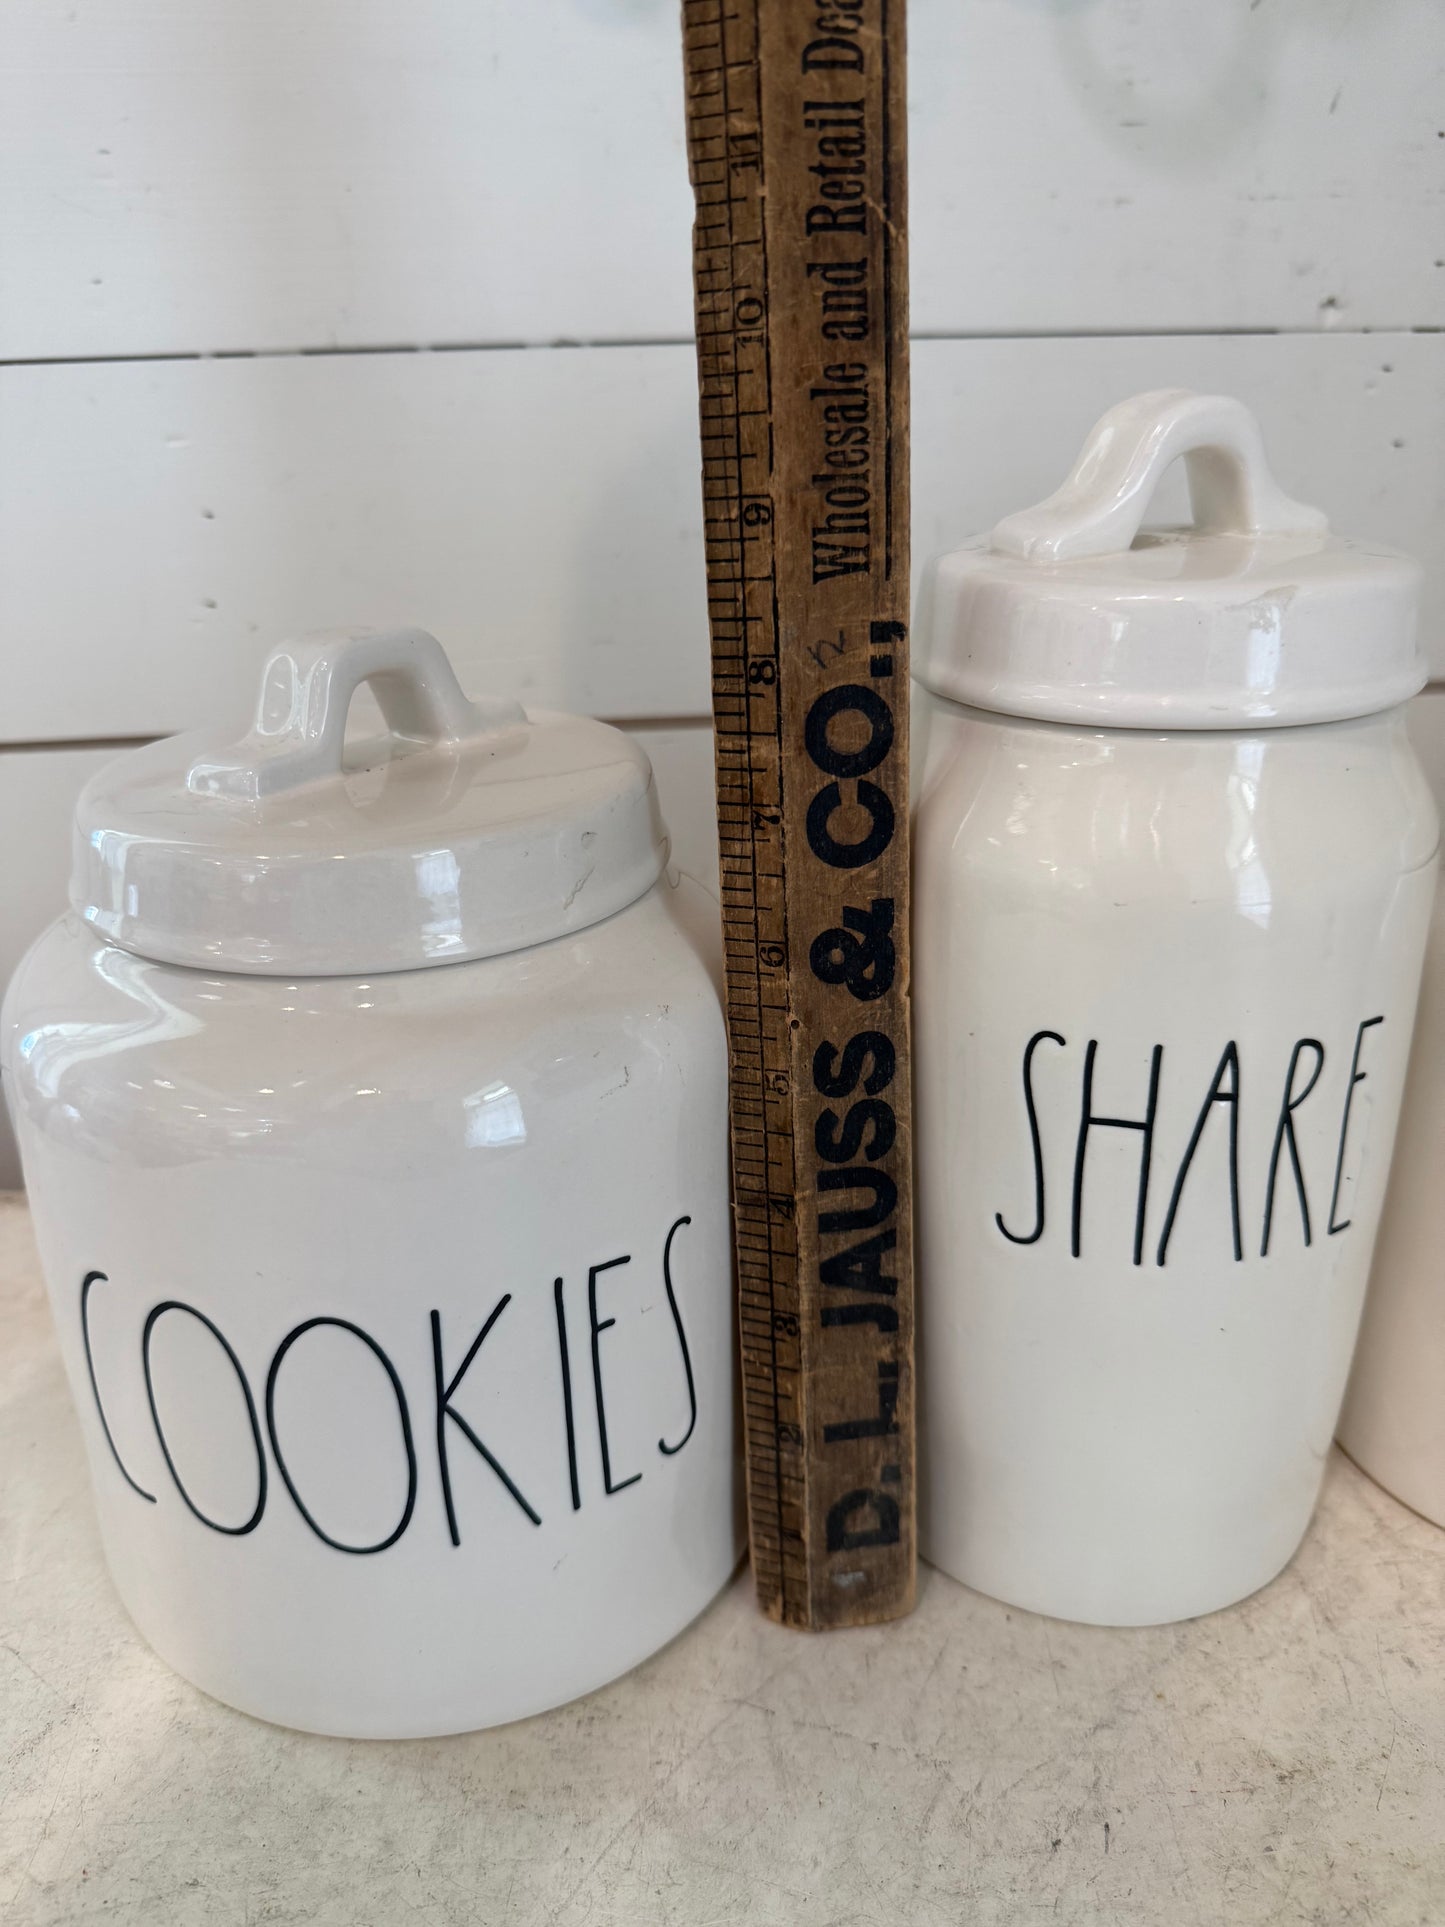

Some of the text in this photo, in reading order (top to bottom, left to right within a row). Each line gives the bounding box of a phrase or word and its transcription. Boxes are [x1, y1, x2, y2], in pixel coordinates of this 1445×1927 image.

[729, 133, 759, 177] 11
[804, 98, 867, 237] Retail
[736, 297, 765, 349] 10
[807, 257, 870, 341] and
[809, 362, 872, 584] Wholesale
[743, 502, 771, 527] 9
[750, 660, 776, 685] 8
[804, 621, 907, 869] CO.,
[753, 808, 780, 830] 7
[760, 946, 786, 967] 6
[809, 897, 896, 1001] &
[764, 1073, 790, 1096] 5
[995, 1015, 1384, 1267] SHARE
[812, 1031, 899, 1333] JAUSS
[771, 1198, 794, 1219] 4
[773, 1315, 799, 1337] 3
[81, 1216, 697, 1554] COOKIES
